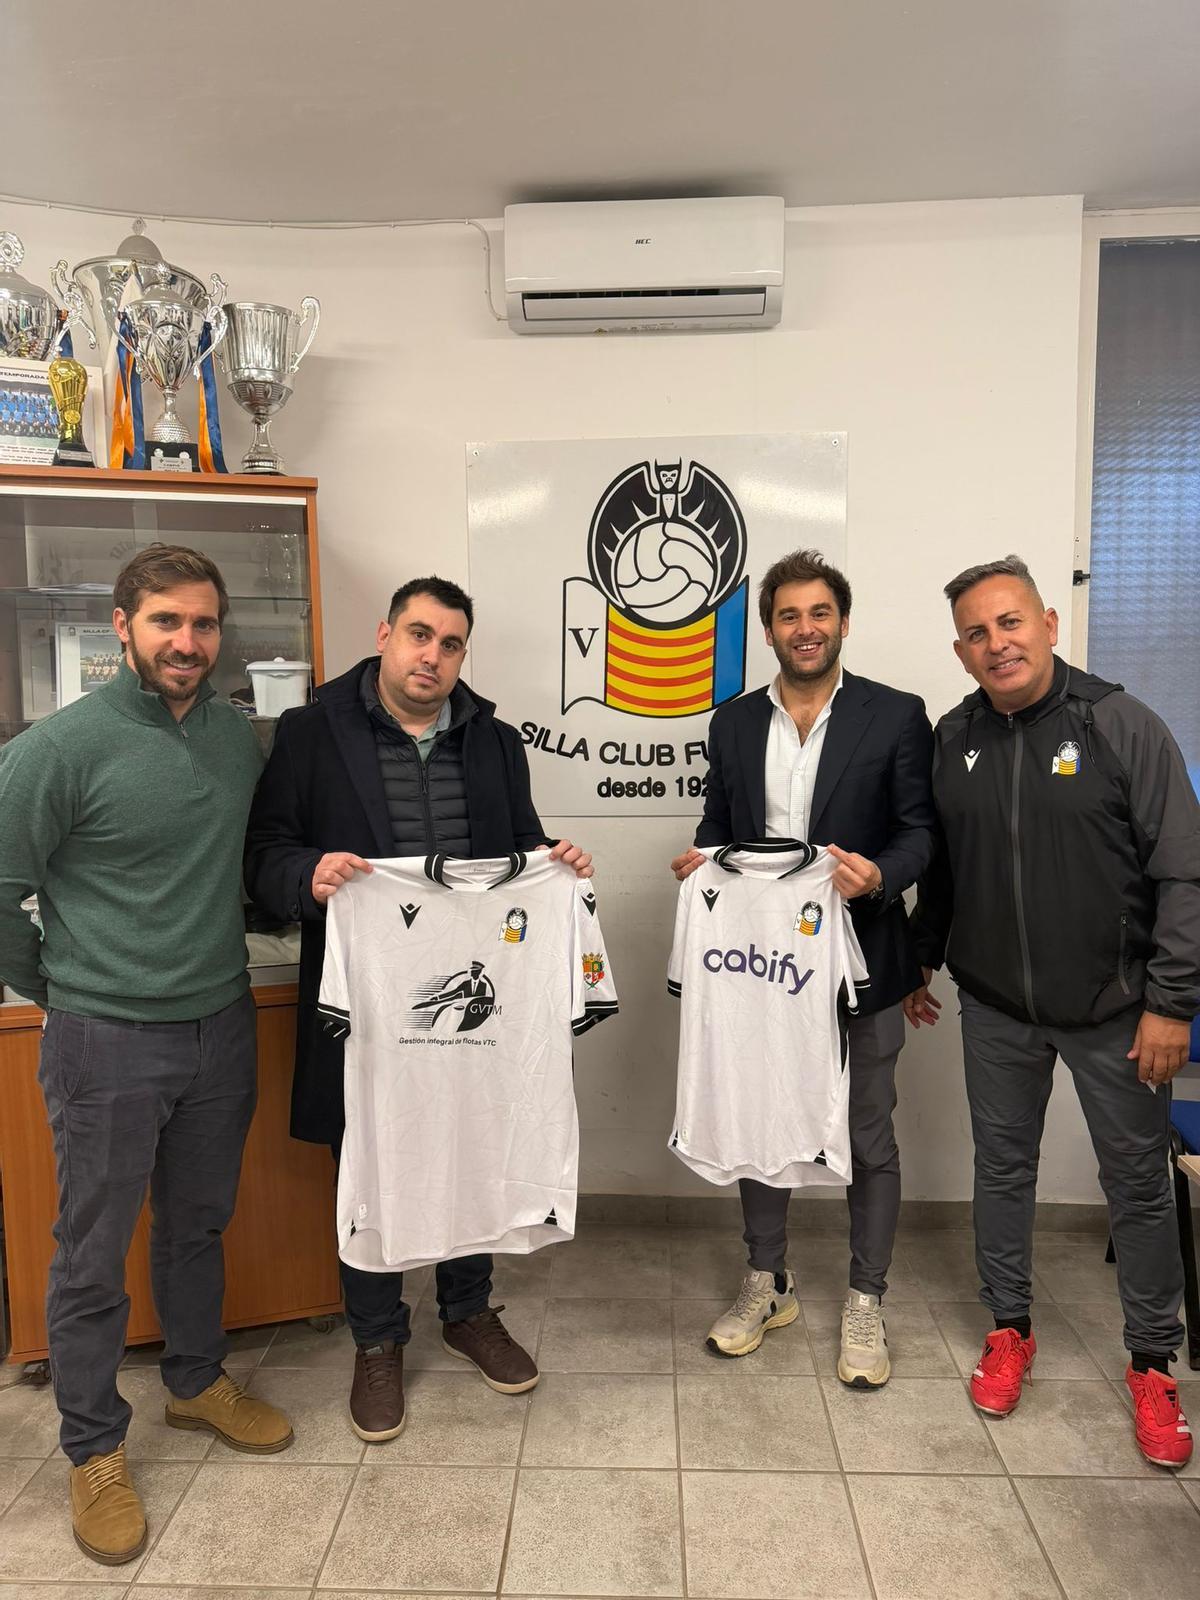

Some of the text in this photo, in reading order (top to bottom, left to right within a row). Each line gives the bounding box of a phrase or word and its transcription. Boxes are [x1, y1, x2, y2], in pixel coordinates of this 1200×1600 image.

[0, 371, 45, 380] TEMPORADA
[568, 627, 599, 658] V
[520, 721, 590, 762] SILLA
[599, 741, 676, 767] CLUB
[597, 776, 666, 798] desde
[703, 943, 815, 995] cabify
[469, 1003, 502, 1015] GVTM
[399, 1036, 425, 1045] Gestión
[427, 1037, 454, 1047] integral
[463, 1038, 482, 1046] flotas
[483, 1039, 497, 1047] VTC
